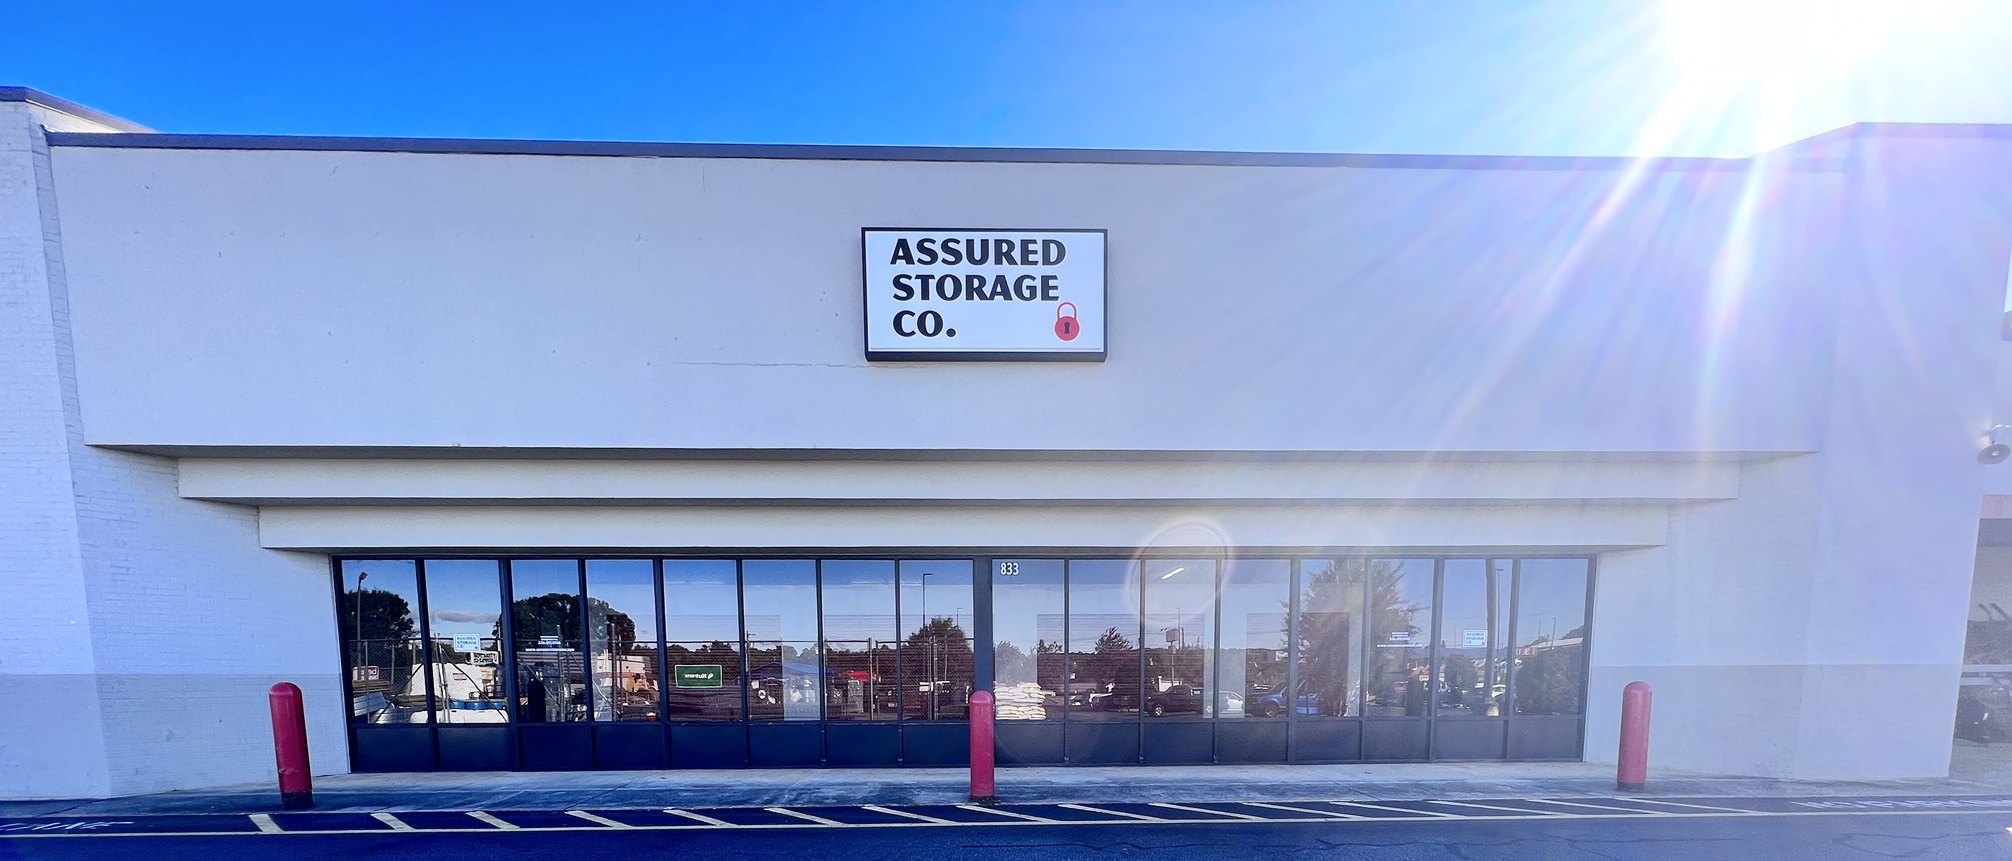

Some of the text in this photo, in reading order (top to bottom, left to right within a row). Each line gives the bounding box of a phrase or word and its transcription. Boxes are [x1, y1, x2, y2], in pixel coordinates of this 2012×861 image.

[890, 238, 1066, 265] ASSURED
[892, 274, 1060, 301] STORAGE
[892, 310, 957, 337] CO.
[1000, 562, 1019, 575] 833
